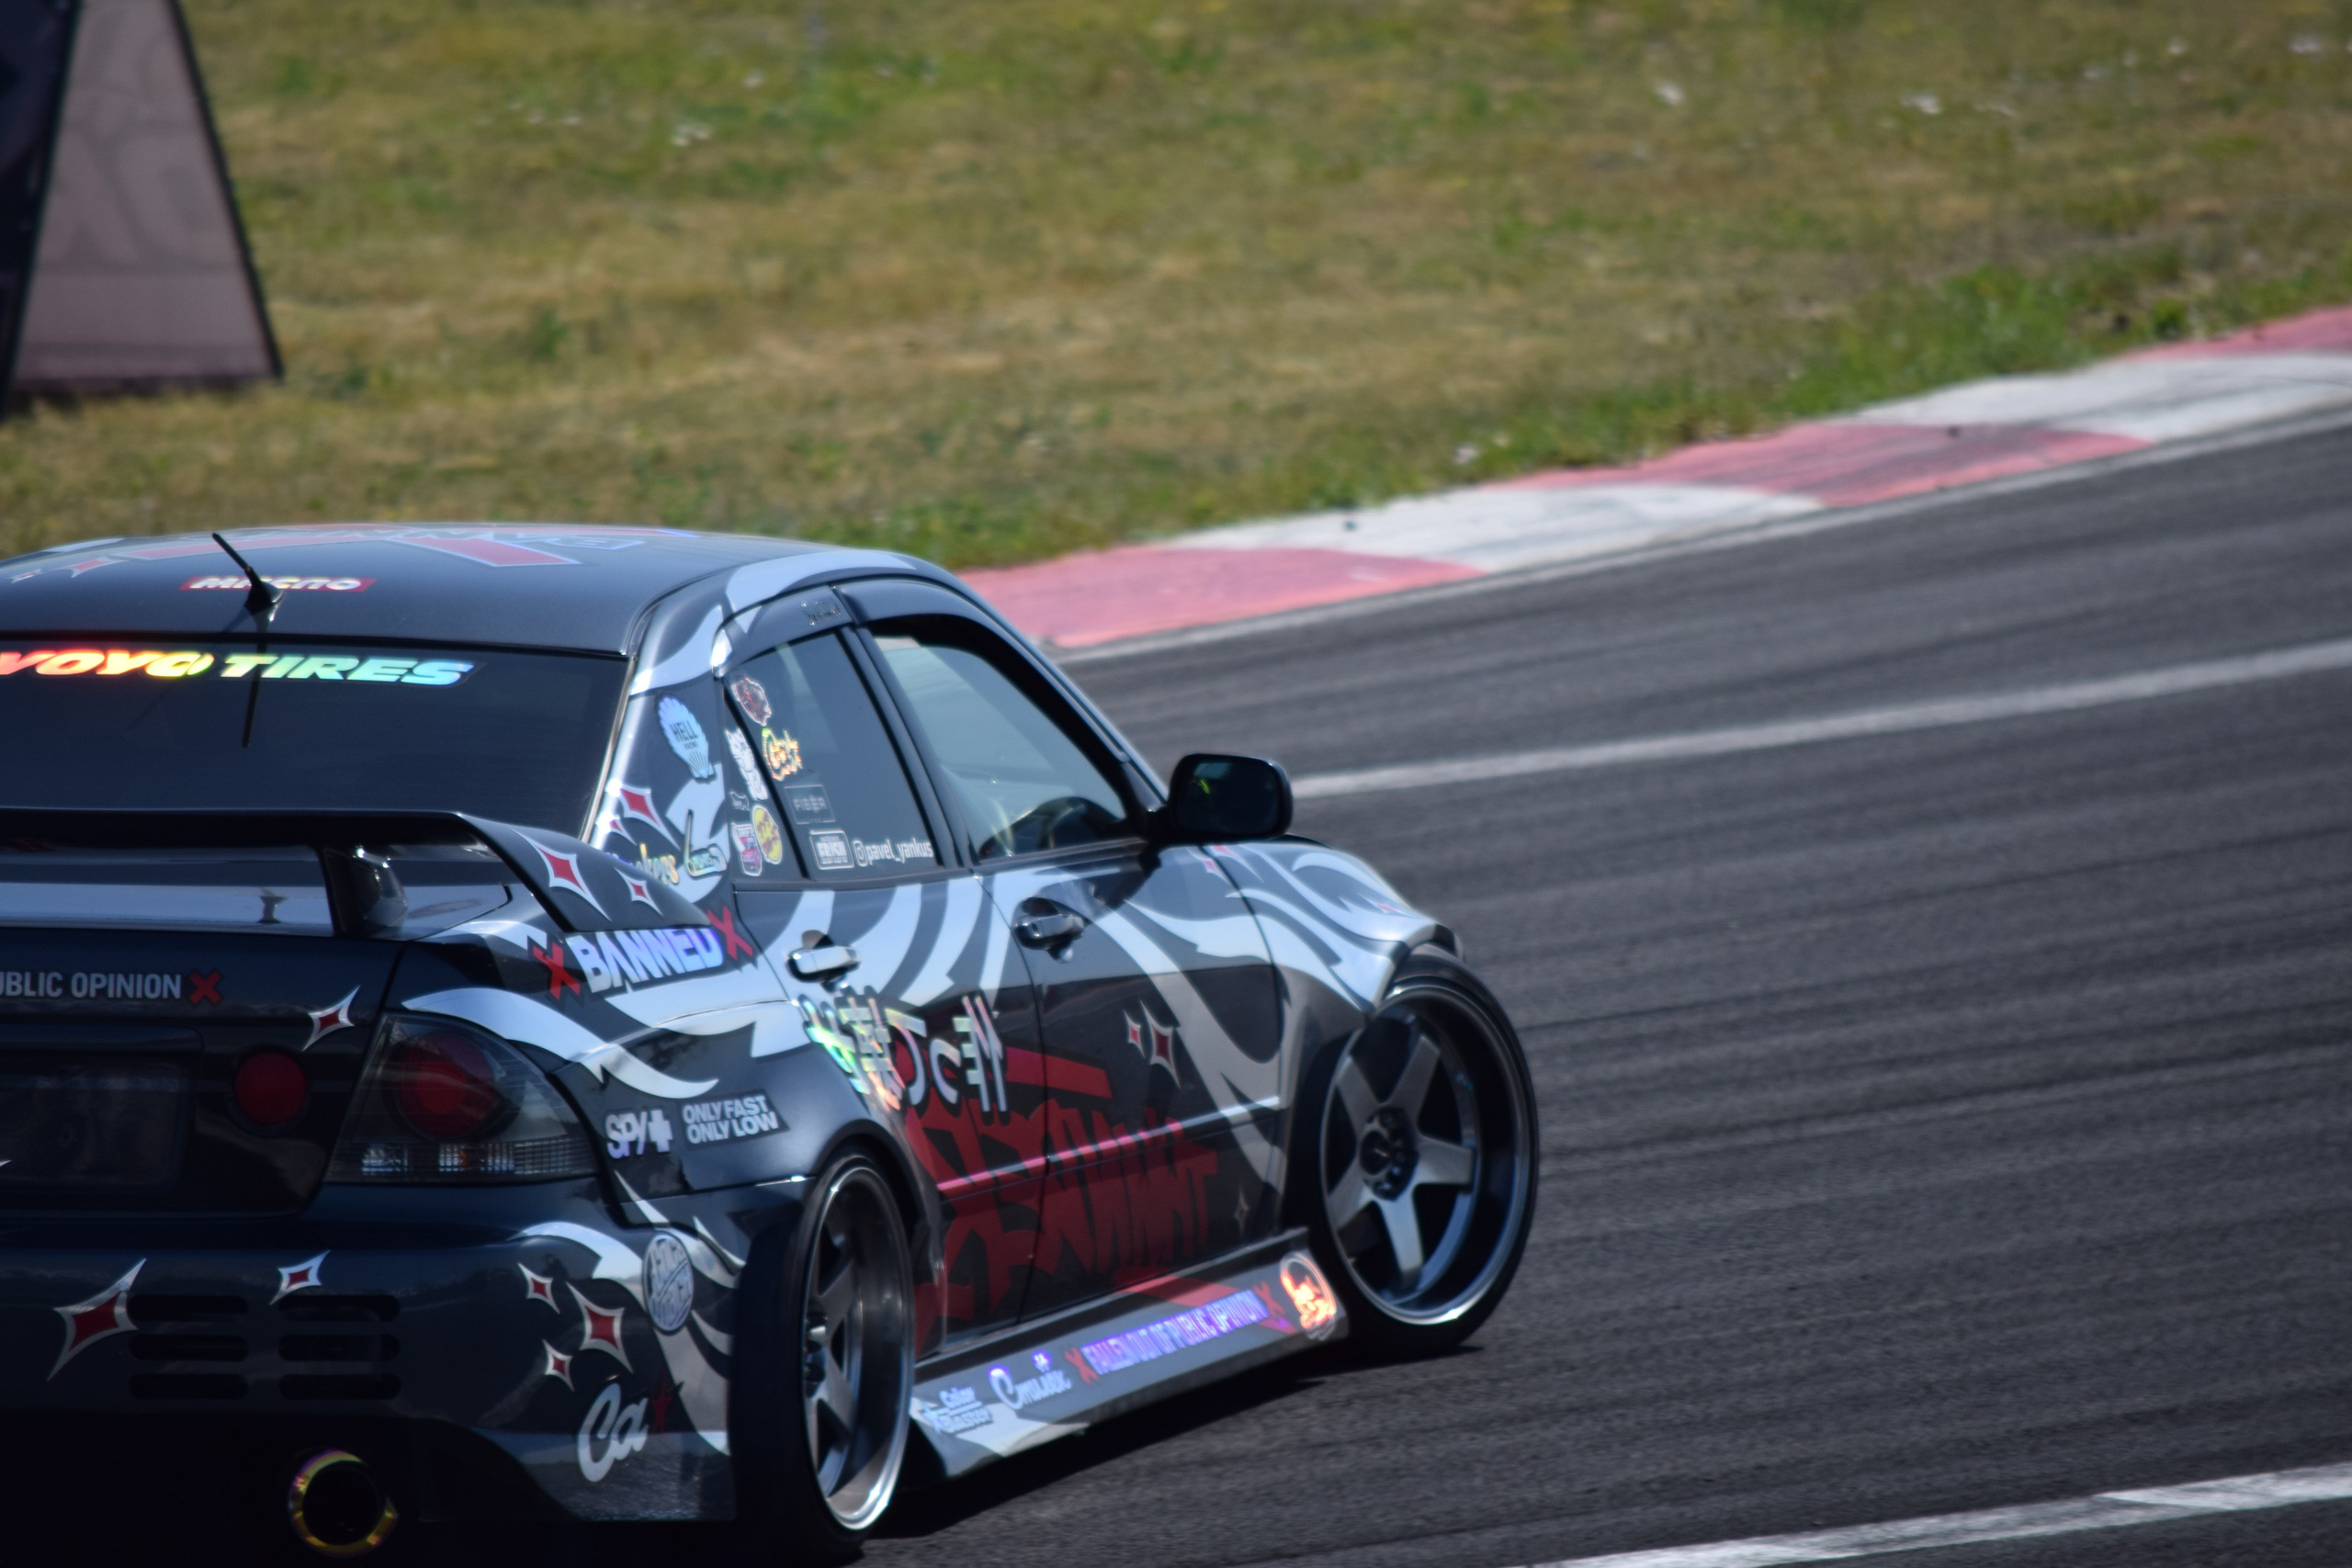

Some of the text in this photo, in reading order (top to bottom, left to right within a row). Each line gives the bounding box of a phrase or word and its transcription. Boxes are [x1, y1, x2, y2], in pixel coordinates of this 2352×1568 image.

[220, 653, 473, 686] TIRES
[669, 721, 698, 742] HELL
[566, 928, 723, 993] BANNED
[71, 972, 182, 999] OPINION
[683, 1095, 769, 1124] ONLY FAST
[686, 1111, 779, 1145] ONLY LOW
[1161, 1307, 1219, 1349] PUBLIC
[1202, 1288, 1271, 1334] OPINION
[1123, 1326, 1163, 1362] OUT
[1146, 1320, 1180, 1354] OF
